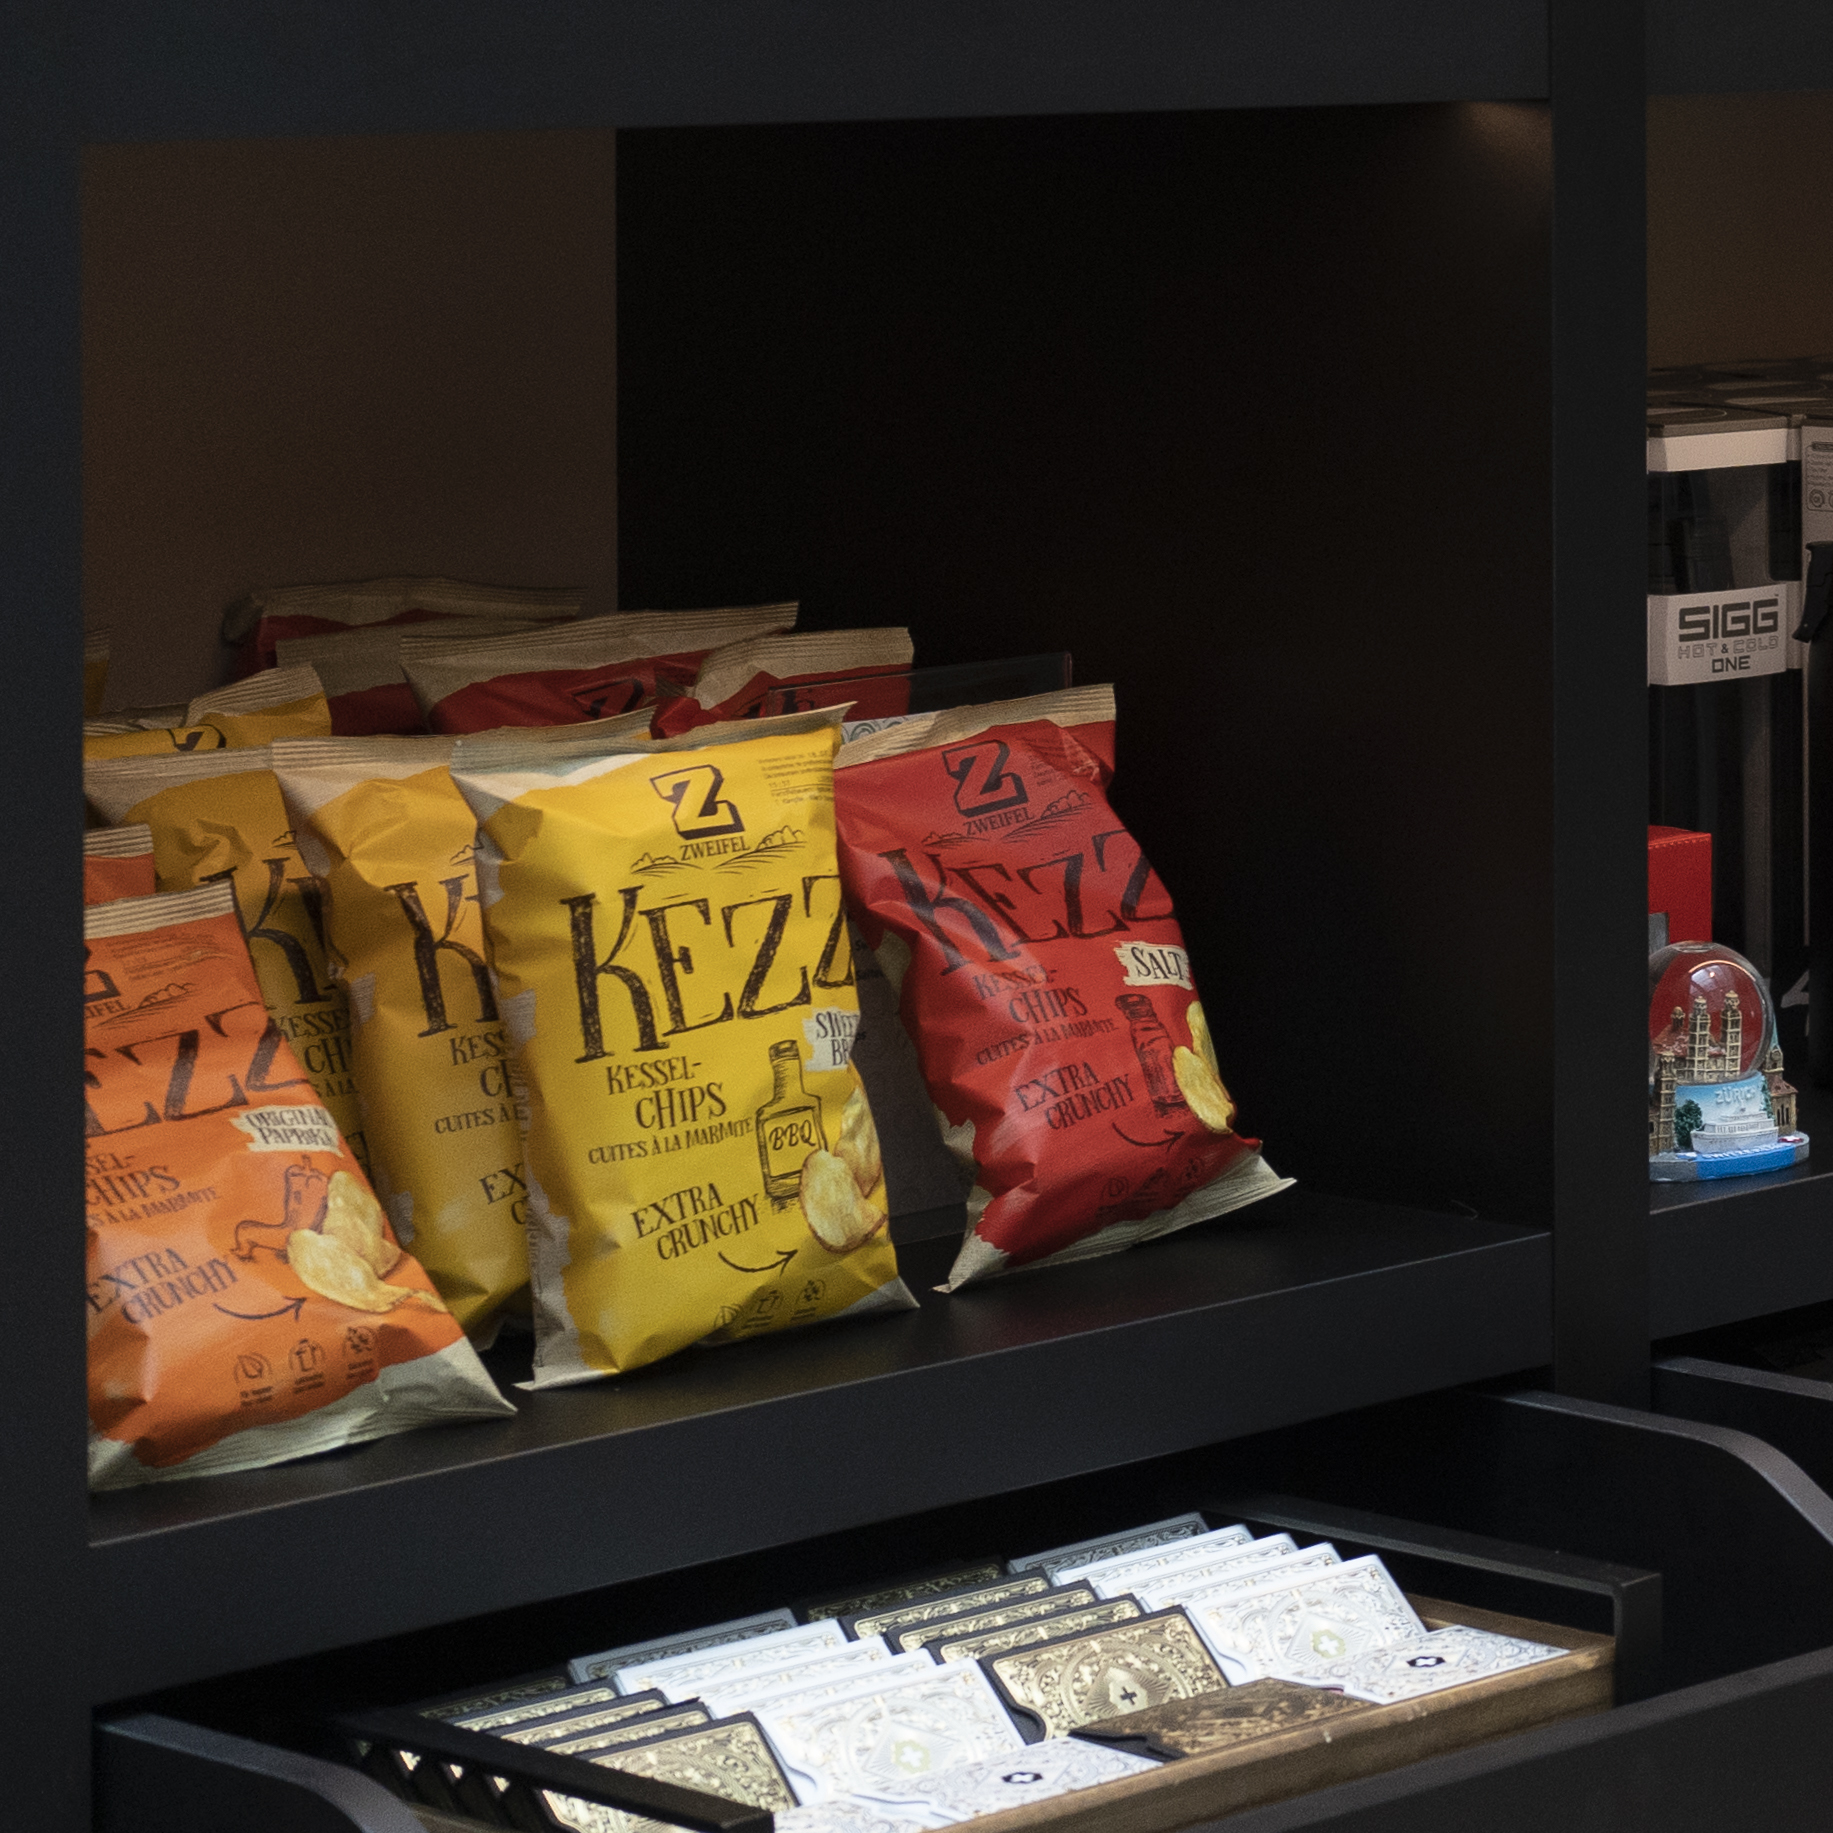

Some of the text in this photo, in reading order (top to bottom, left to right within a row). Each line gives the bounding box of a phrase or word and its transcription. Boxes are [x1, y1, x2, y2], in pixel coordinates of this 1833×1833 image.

[1678, 598, 1779, 643] SIGG
[1678, 635, 1779, 660] HOT & COLD
[1711, 655, 1751, 673] ONE
[963, 807, 1035, 837] ZWEIFEL
[679, 836, 750, 861] ZWEIFEL
[559, 872, 854, 1064] KEZZ
[1130, 946, 1185, 980] SALT
[1008, 986, 1088, 1025] CHIPS
[606, 1056, 702, 1096] KESSEL-
[1013, 1061, 1100, 1112] EXTRA
[634, 1082, 727, 1131] CHIPS
[1046, 1073, 1135, 1130] CRUNCHY
[588, 1137, 649, 1164] CUITES
[663, 1132, 683, 1152] LA
[769, 1119, 816, 1151] BBQ
[630, 1182, 724, 1240] EXTRA
[656, 1193, 761, 1261] CRUNCHY
[121, 1257, 239, 1325] CRUNCHY
